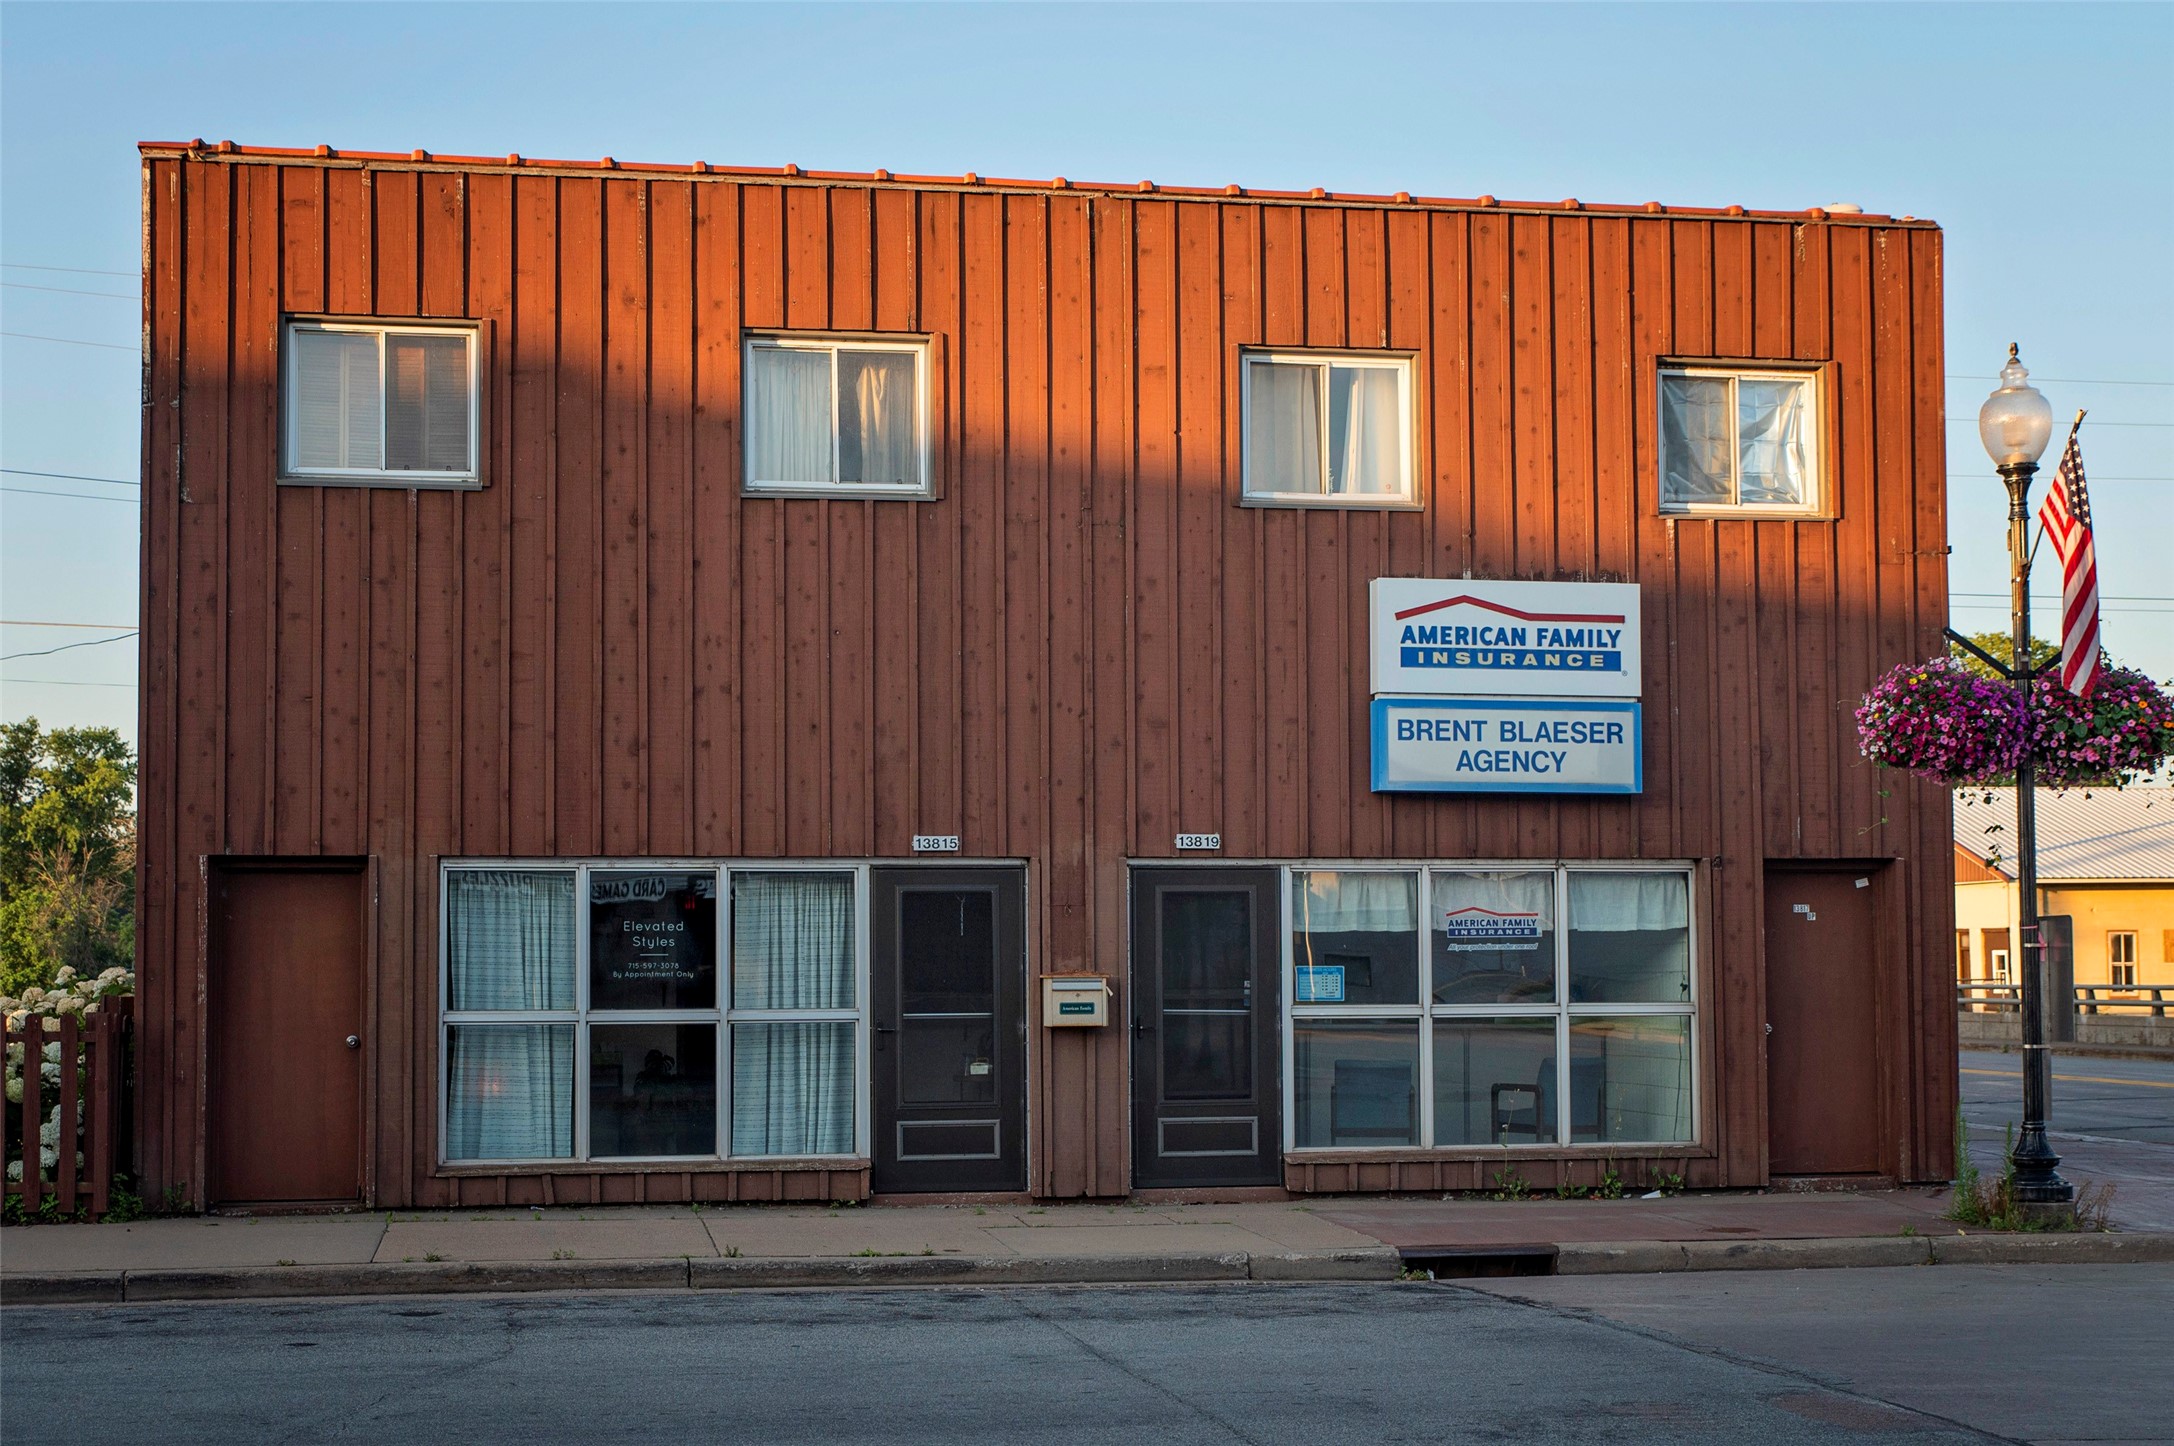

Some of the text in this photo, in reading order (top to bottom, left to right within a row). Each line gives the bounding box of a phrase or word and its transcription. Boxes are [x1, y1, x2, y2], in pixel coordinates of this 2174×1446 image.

[1400, 625, 1621, 648] AMERICAN FAMILY
[1418, 651, 1604, 667] INSURANCE
[1397, 719, 1623, 744] BRENT BLAESER
[1456, 750, 1566, 773] AGENCY
[915, 837, 958, 849] 13815
[1178, 836, 1219, 847] 13819
[623, 921, 684, 931] Elevated
[1448, 919, 1499, 927] AMERICAN
[632, 936, 675, 949] Styles
